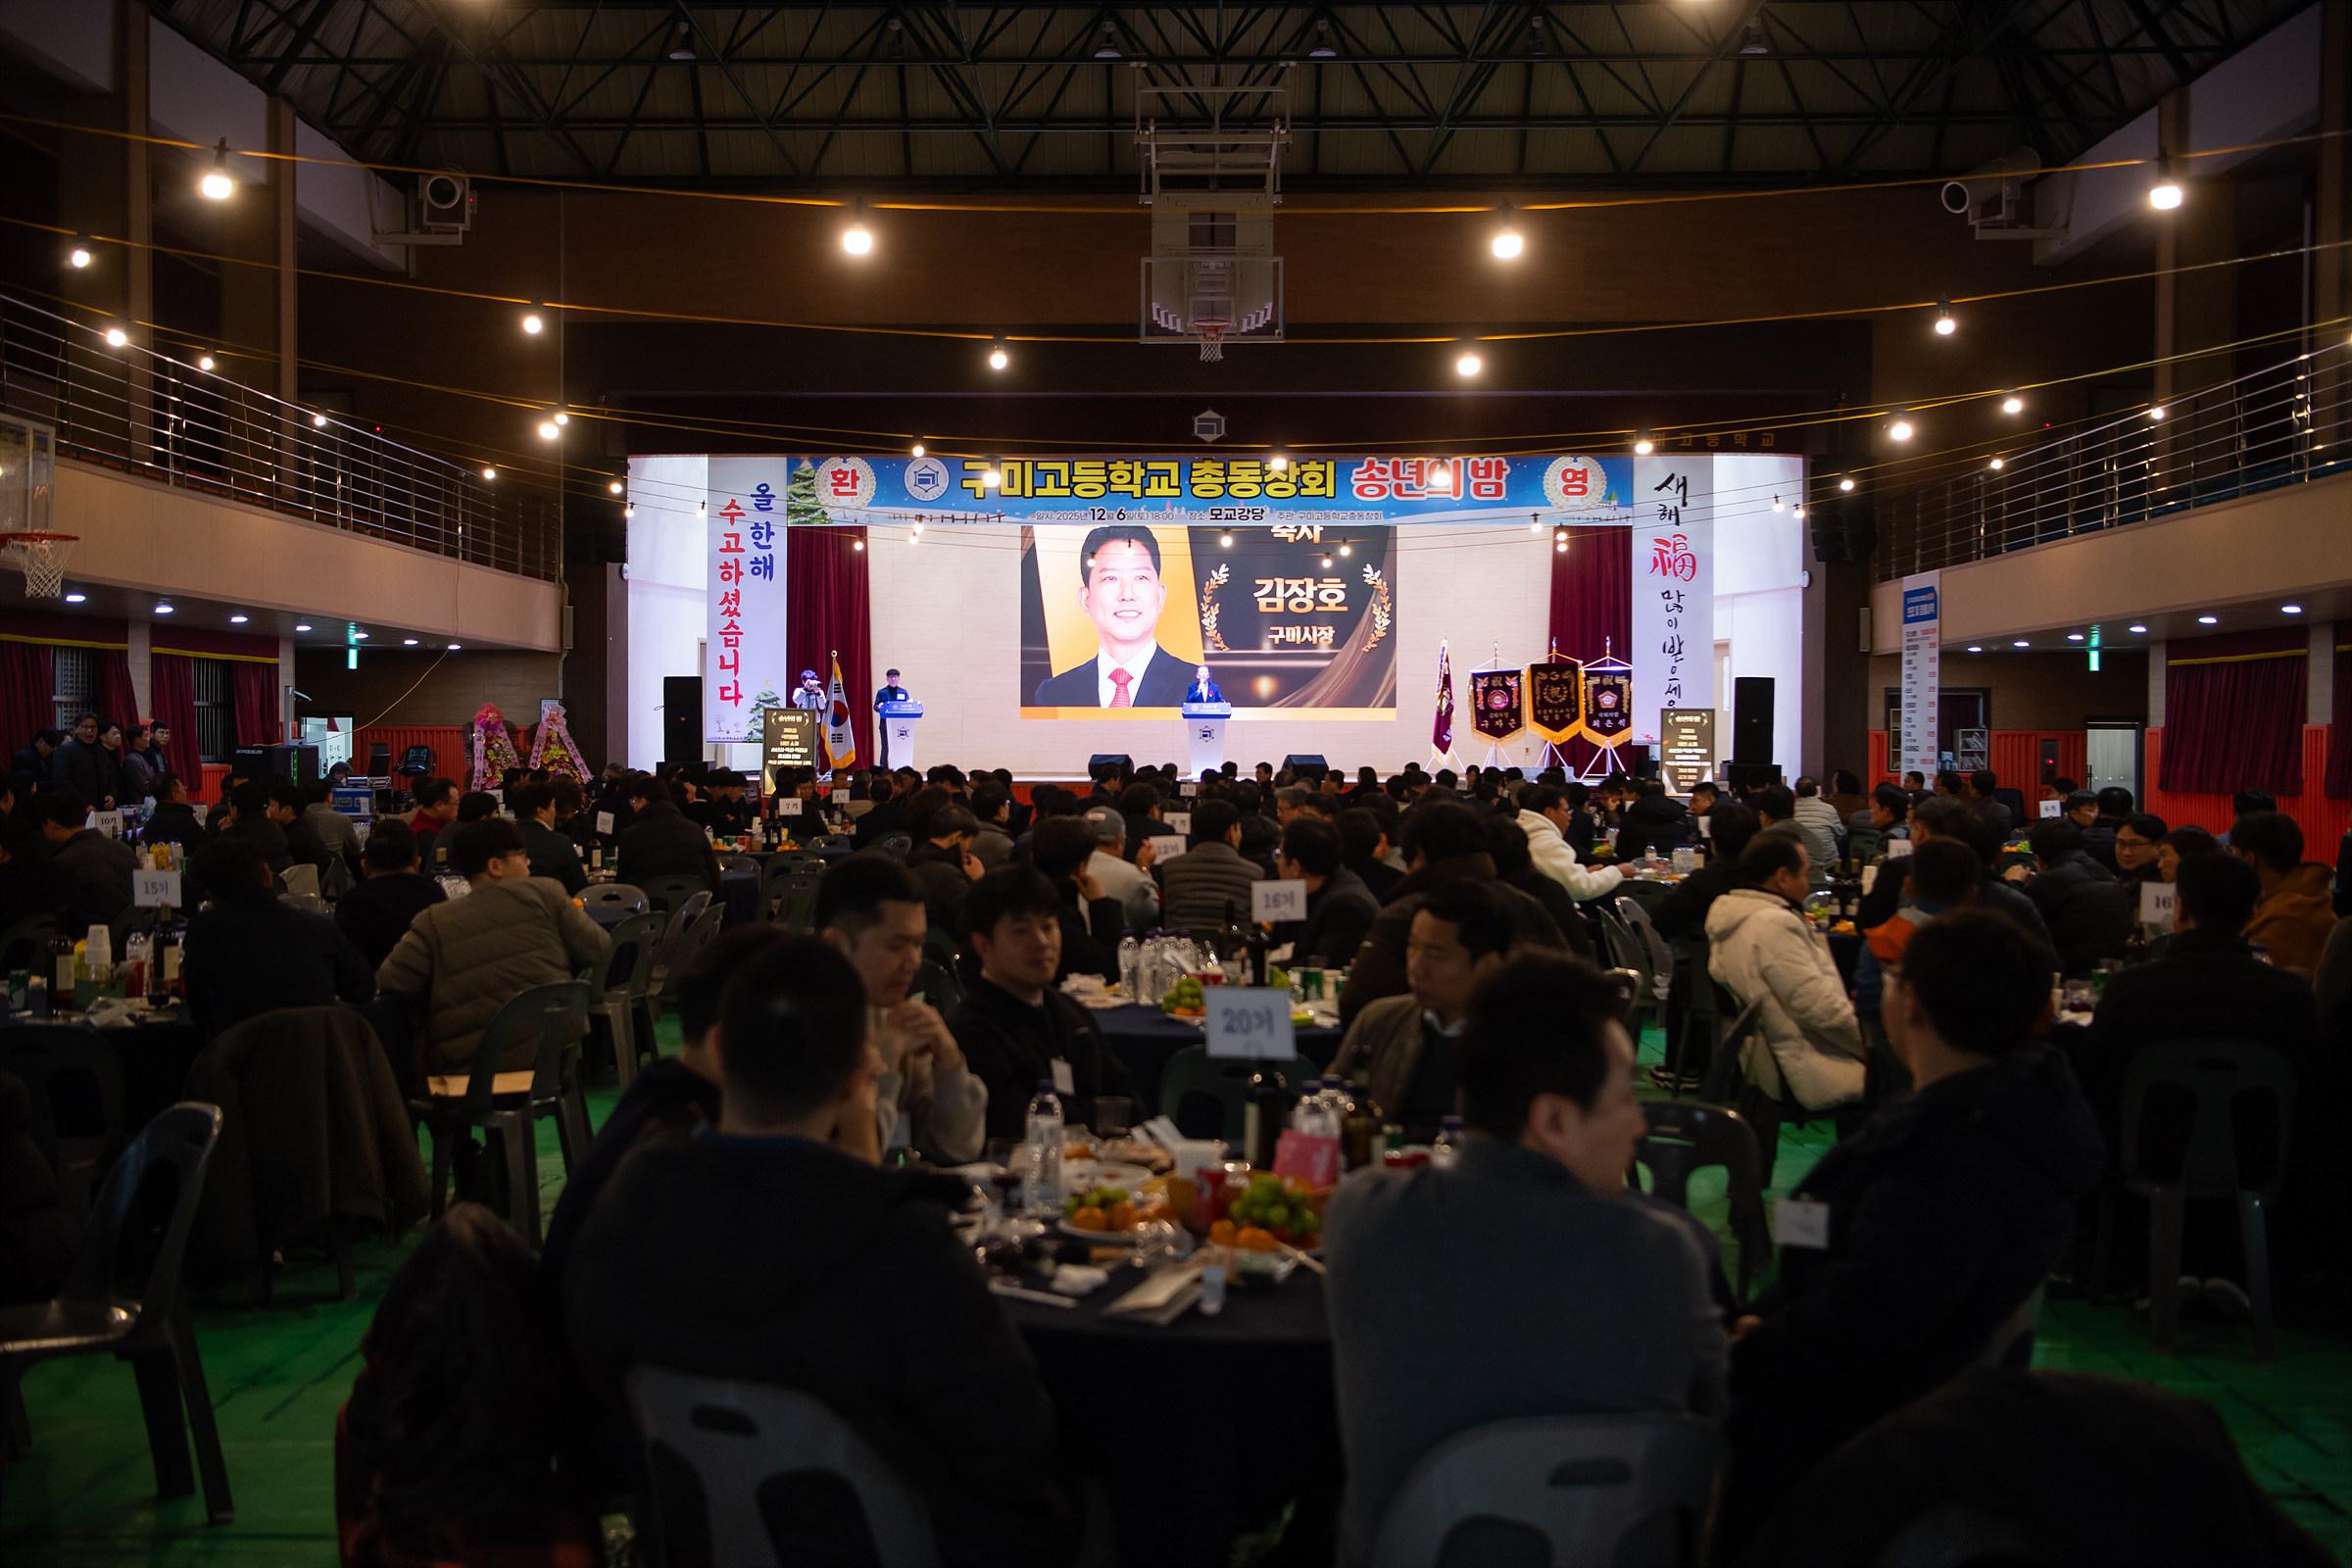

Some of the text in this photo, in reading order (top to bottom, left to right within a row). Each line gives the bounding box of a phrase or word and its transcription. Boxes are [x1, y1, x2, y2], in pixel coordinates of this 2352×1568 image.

[830, 468, 860, 497] 환
[960, 457, 1510, 501] 구미고등학교 총동창회 송년의 밤
[1561, 467, 1589, 497] 영
[750, 482, 776, 512] 올
[1653, 471, 1689, 527] 새해
[1055, 512, 1089, 521] 2025년
[1208, 507, 1265, 521] 모교강당
[1649, 533, 1697, 584] 福
[717, 498, 747, 709] 수고하셨습니다
[1253, 576, 1349, 613] 김장호
[1267, 625, 1336, 645] 구미시장
[101, 816, 117, 825] 10기
[1222, 1004, 1274, 1039] 20기
